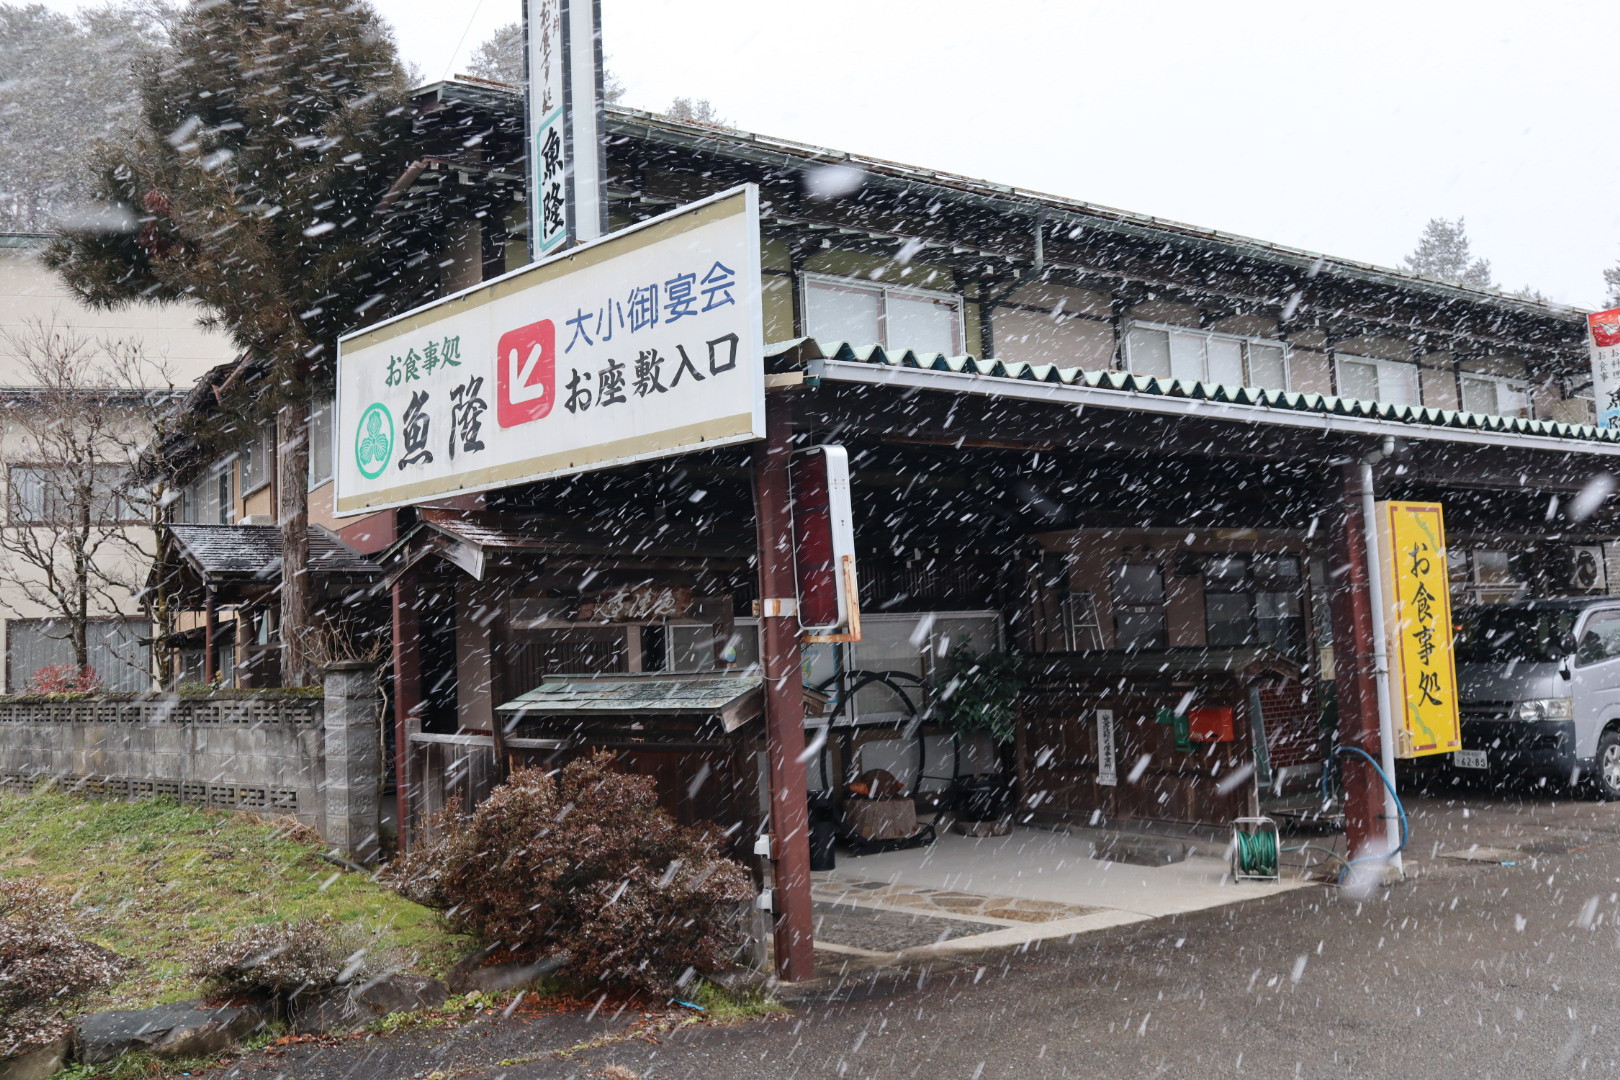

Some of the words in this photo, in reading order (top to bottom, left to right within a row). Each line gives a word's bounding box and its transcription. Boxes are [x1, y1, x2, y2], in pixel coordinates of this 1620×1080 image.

[541, 126, 565, 239] 魚隆
[564, 260, 736, 355] 大小御宴会
[385, 334, 462, 388] お食事処
[563, 332, 740, 415] お座敷入口
[397, 374, 488, 471] 魚隆
[1408, 541, 1443, 708] お食事処
